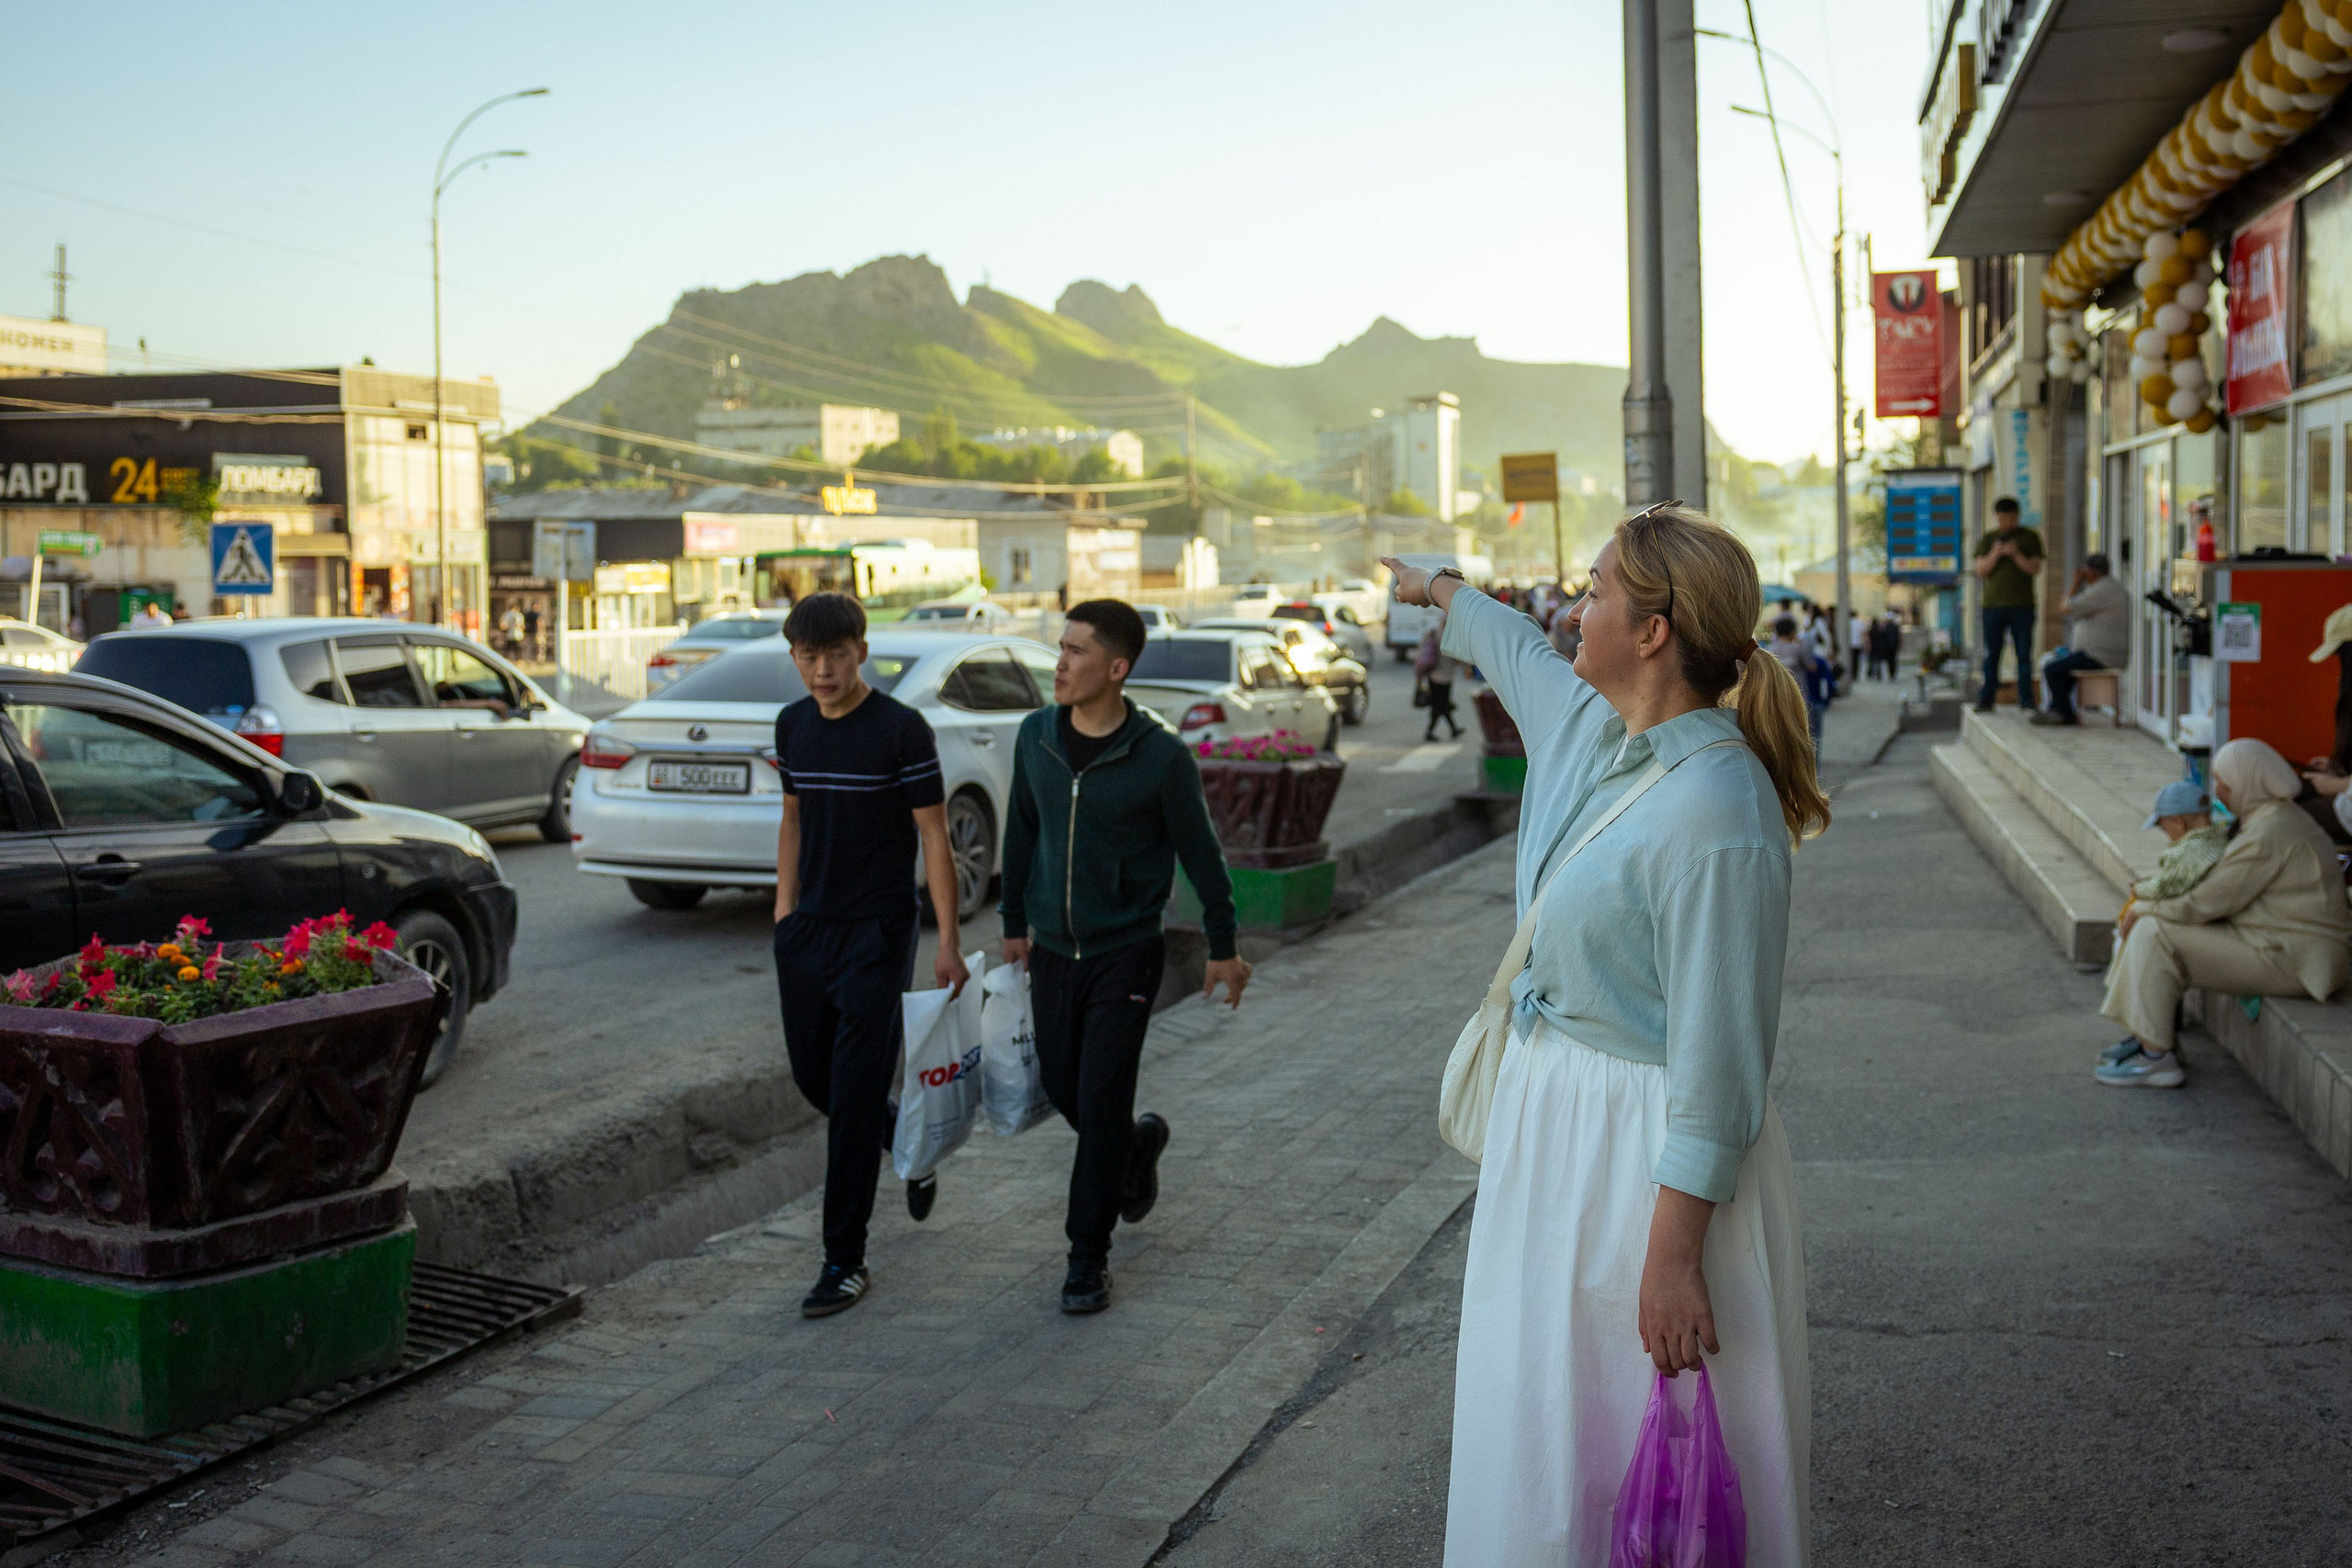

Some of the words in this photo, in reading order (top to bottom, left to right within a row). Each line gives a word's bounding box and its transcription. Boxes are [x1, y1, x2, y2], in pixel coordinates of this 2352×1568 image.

[0, 462, 89, 504] АРД
[109, 457, 158, 503] 24
[220, 464, 322, 497] ЛОМБАРД
